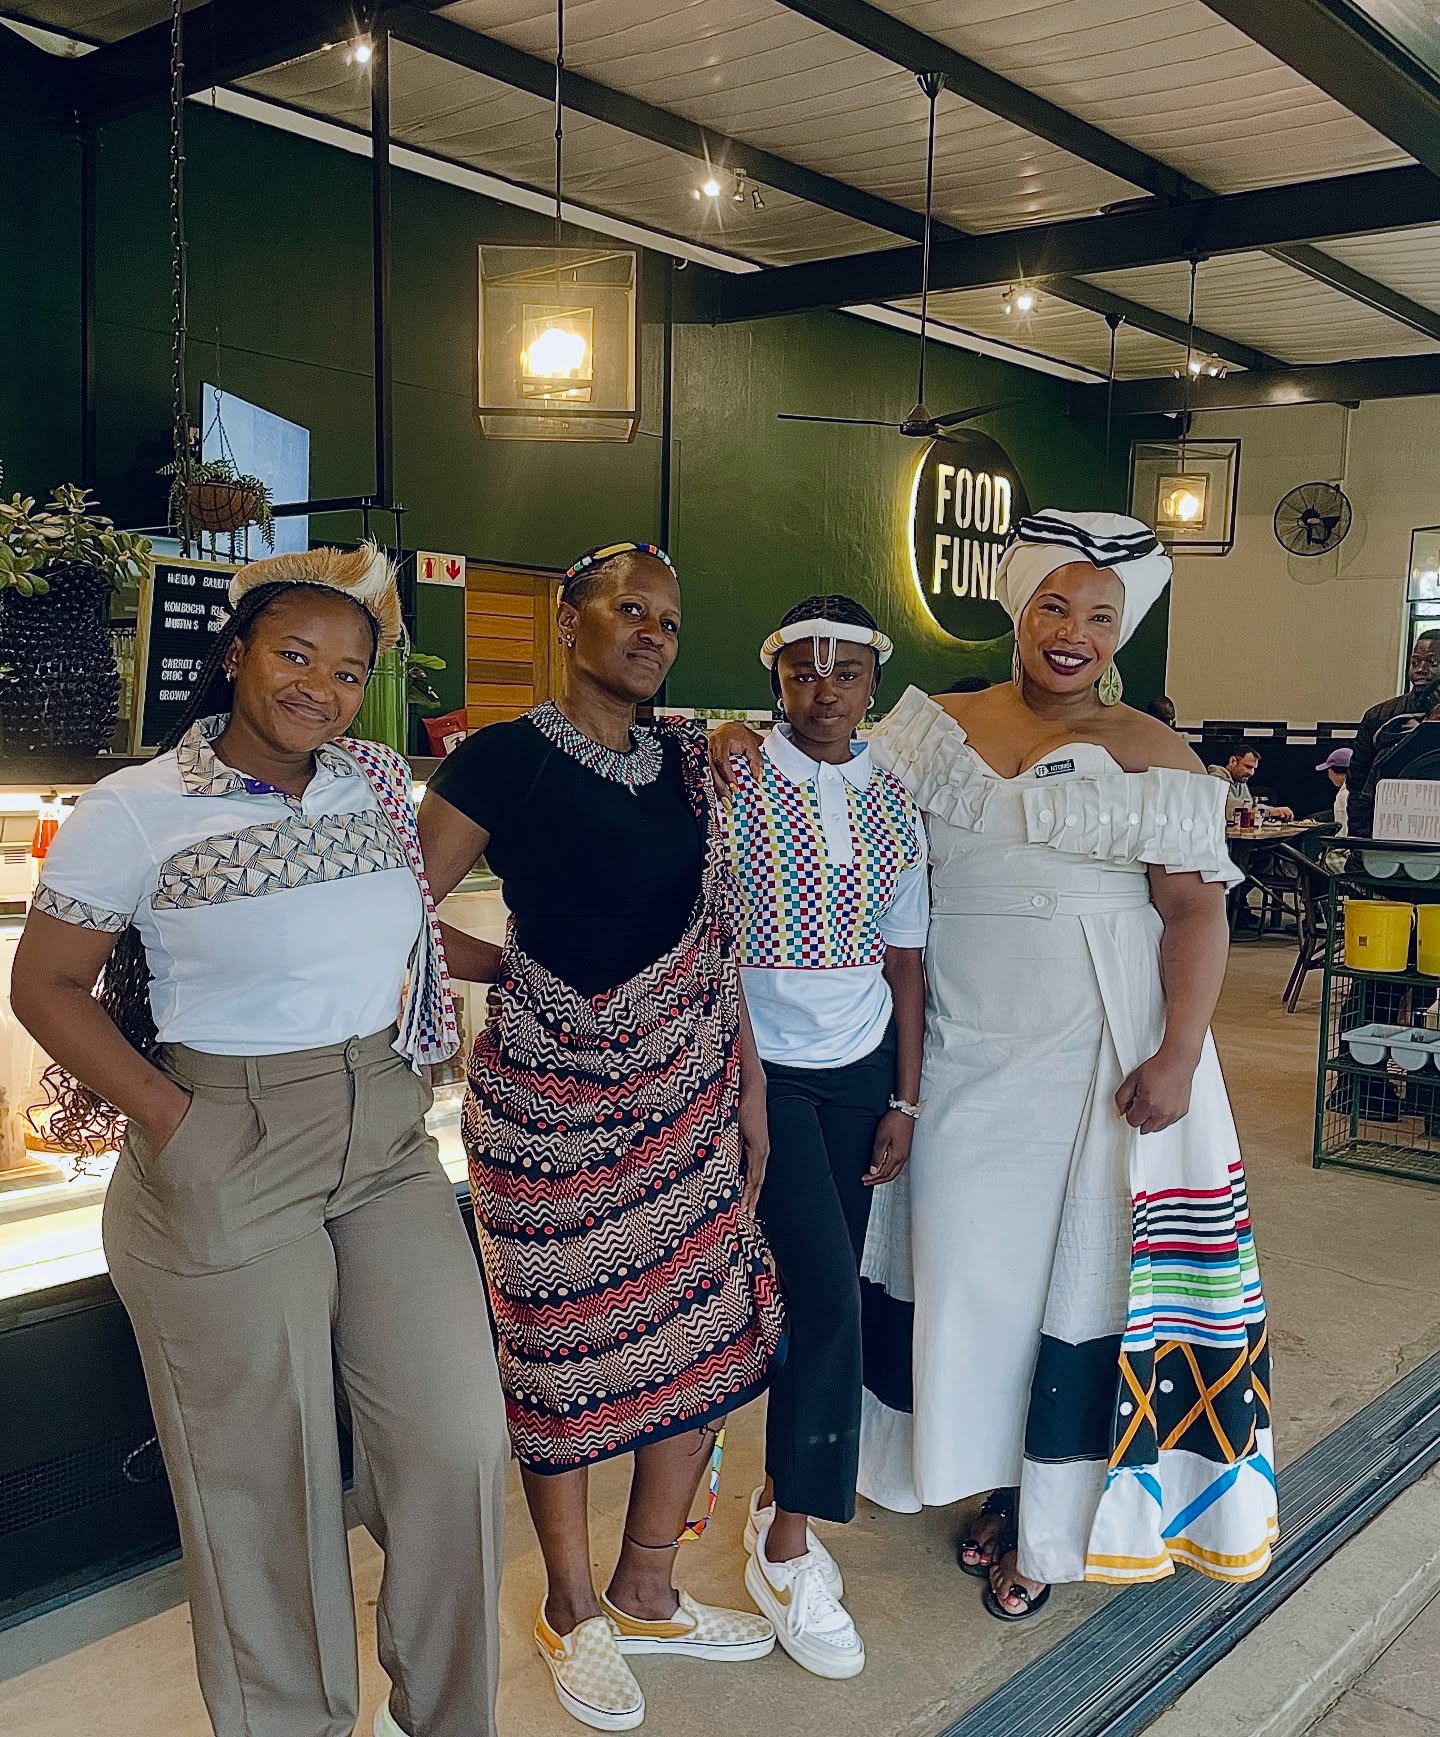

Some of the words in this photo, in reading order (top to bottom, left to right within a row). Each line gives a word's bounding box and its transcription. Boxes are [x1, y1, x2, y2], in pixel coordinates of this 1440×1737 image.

[936, 463, 1011, 536] FOOD
[167, 572, 196, 587] HELLO
[202, 576, 230, 590] BALLIT
[164, 600, 206, 615] KOMBUCHA
[161, 657, 193, 670] CARROT
[161, 670, 183, 681] CHOC
